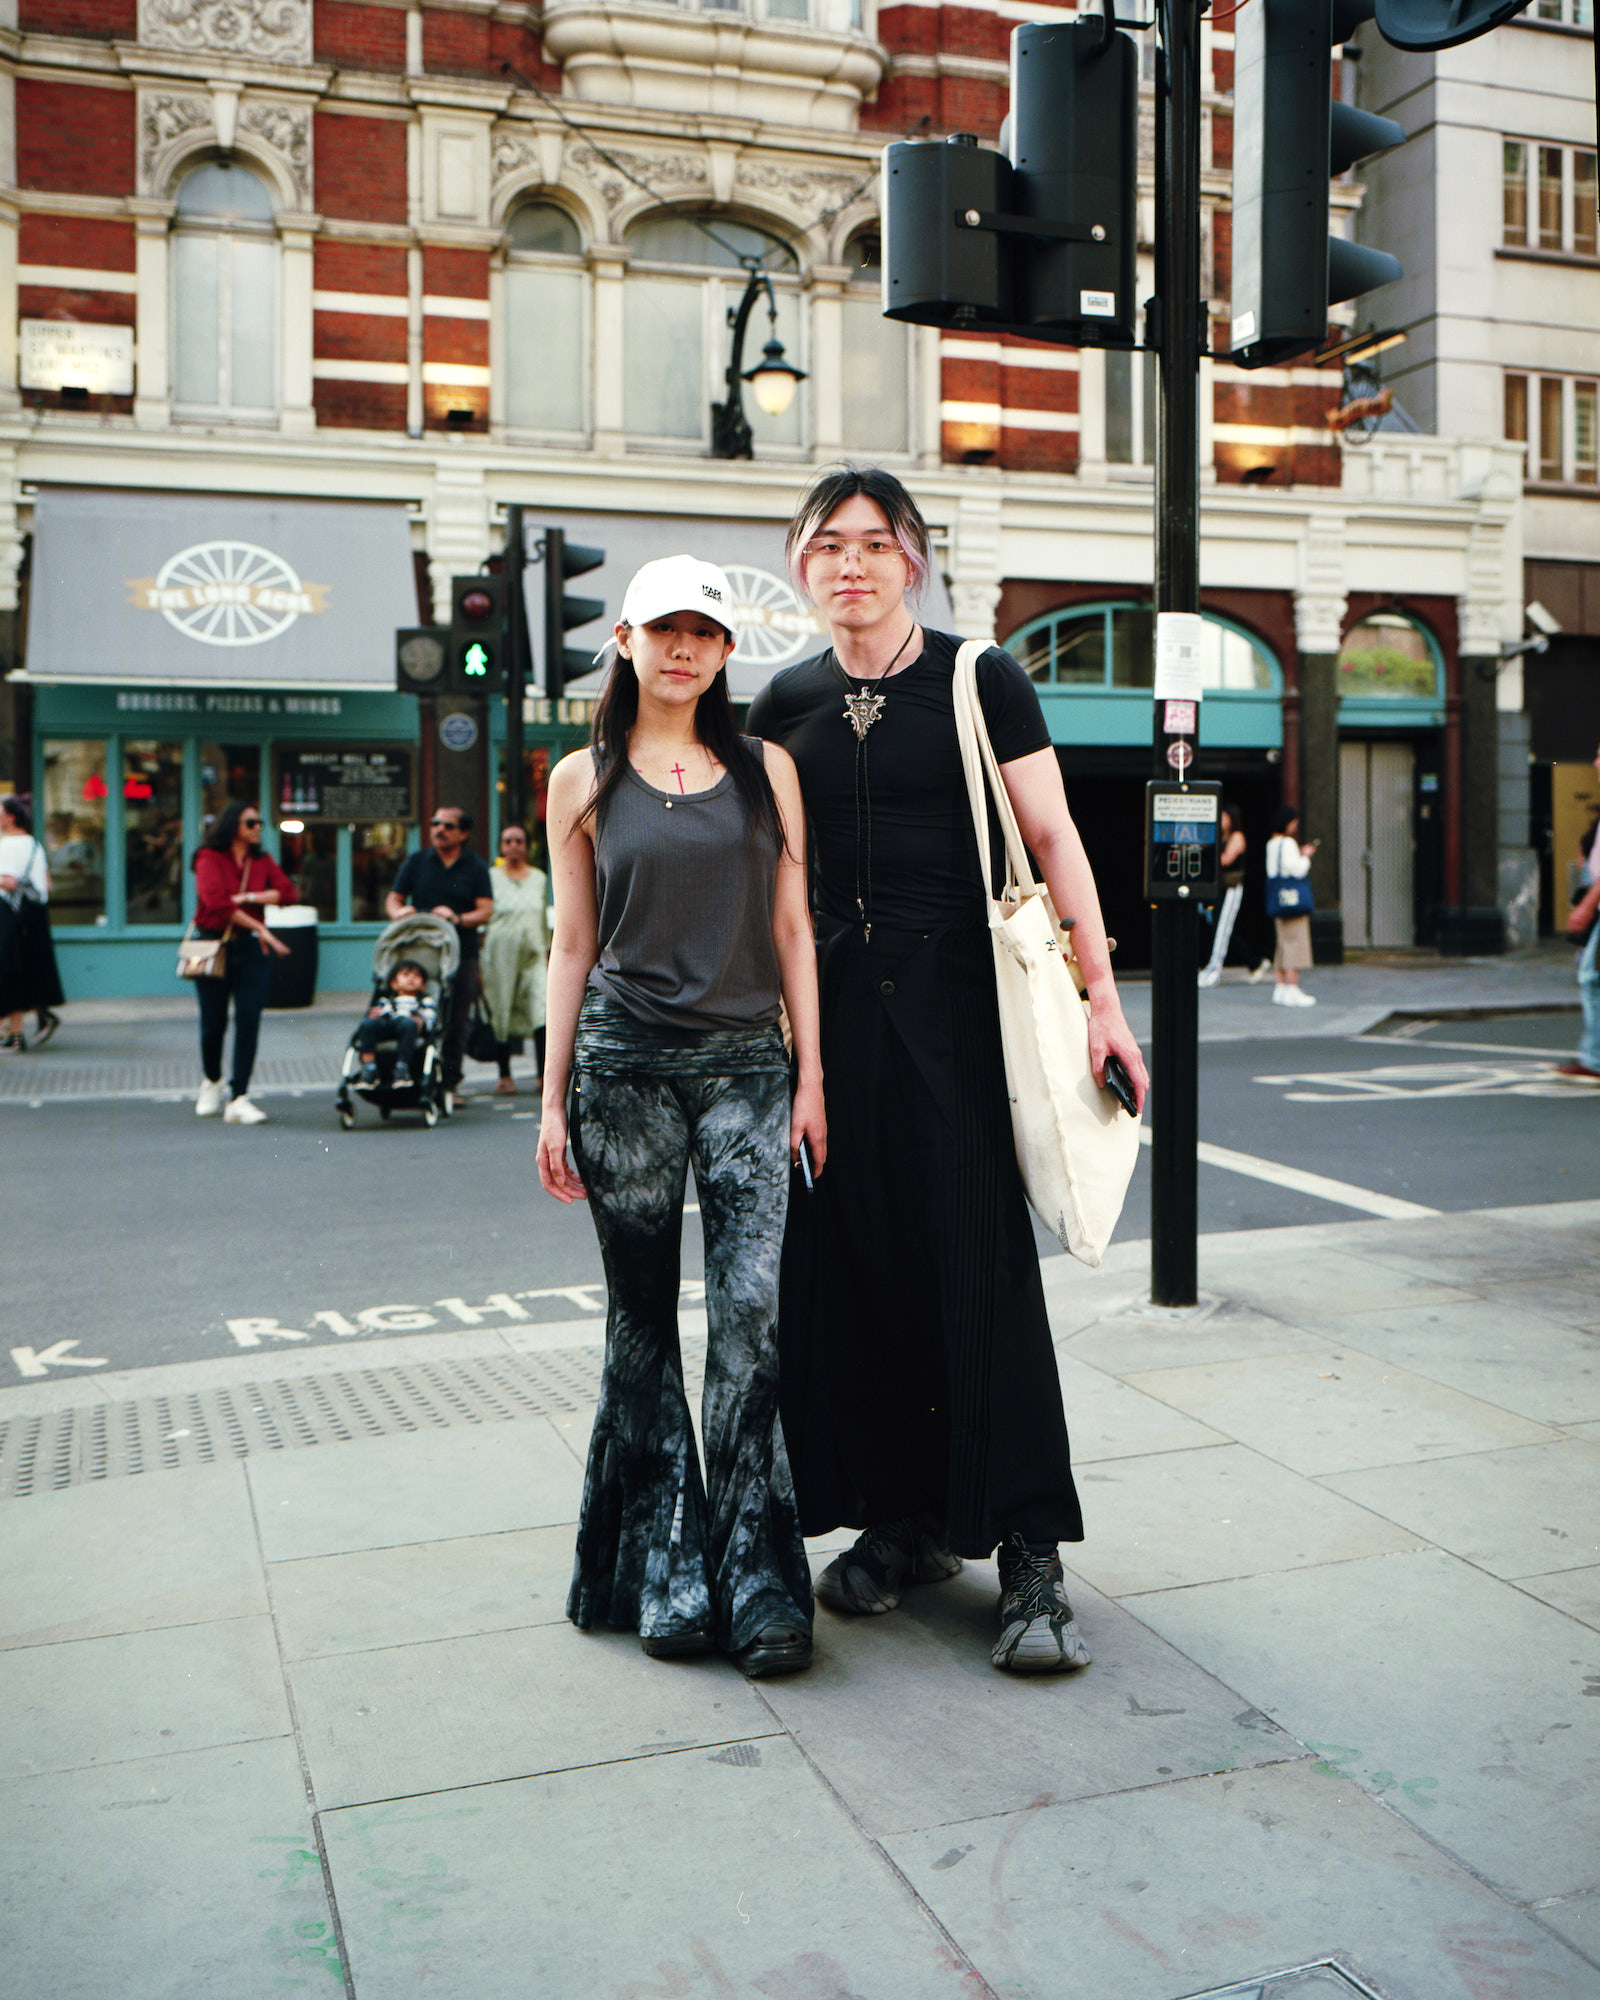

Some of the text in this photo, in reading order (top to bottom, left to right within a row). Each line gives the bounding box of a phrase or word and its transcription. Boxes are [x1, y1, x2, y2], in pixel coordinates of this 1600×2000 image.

[146, 583, 313, 613] THE LONG ACRE
[206, 694, 262, 713] PIZZAS
[268, 698, 280, 714] &
[285, 697, 342, 716] WINGS
[1158, 797, 1213, 805] PEDESTRIANS
[1159, 824, 1212, 842] WAIT
[225, 1284, 606, 1348] RIGHT
